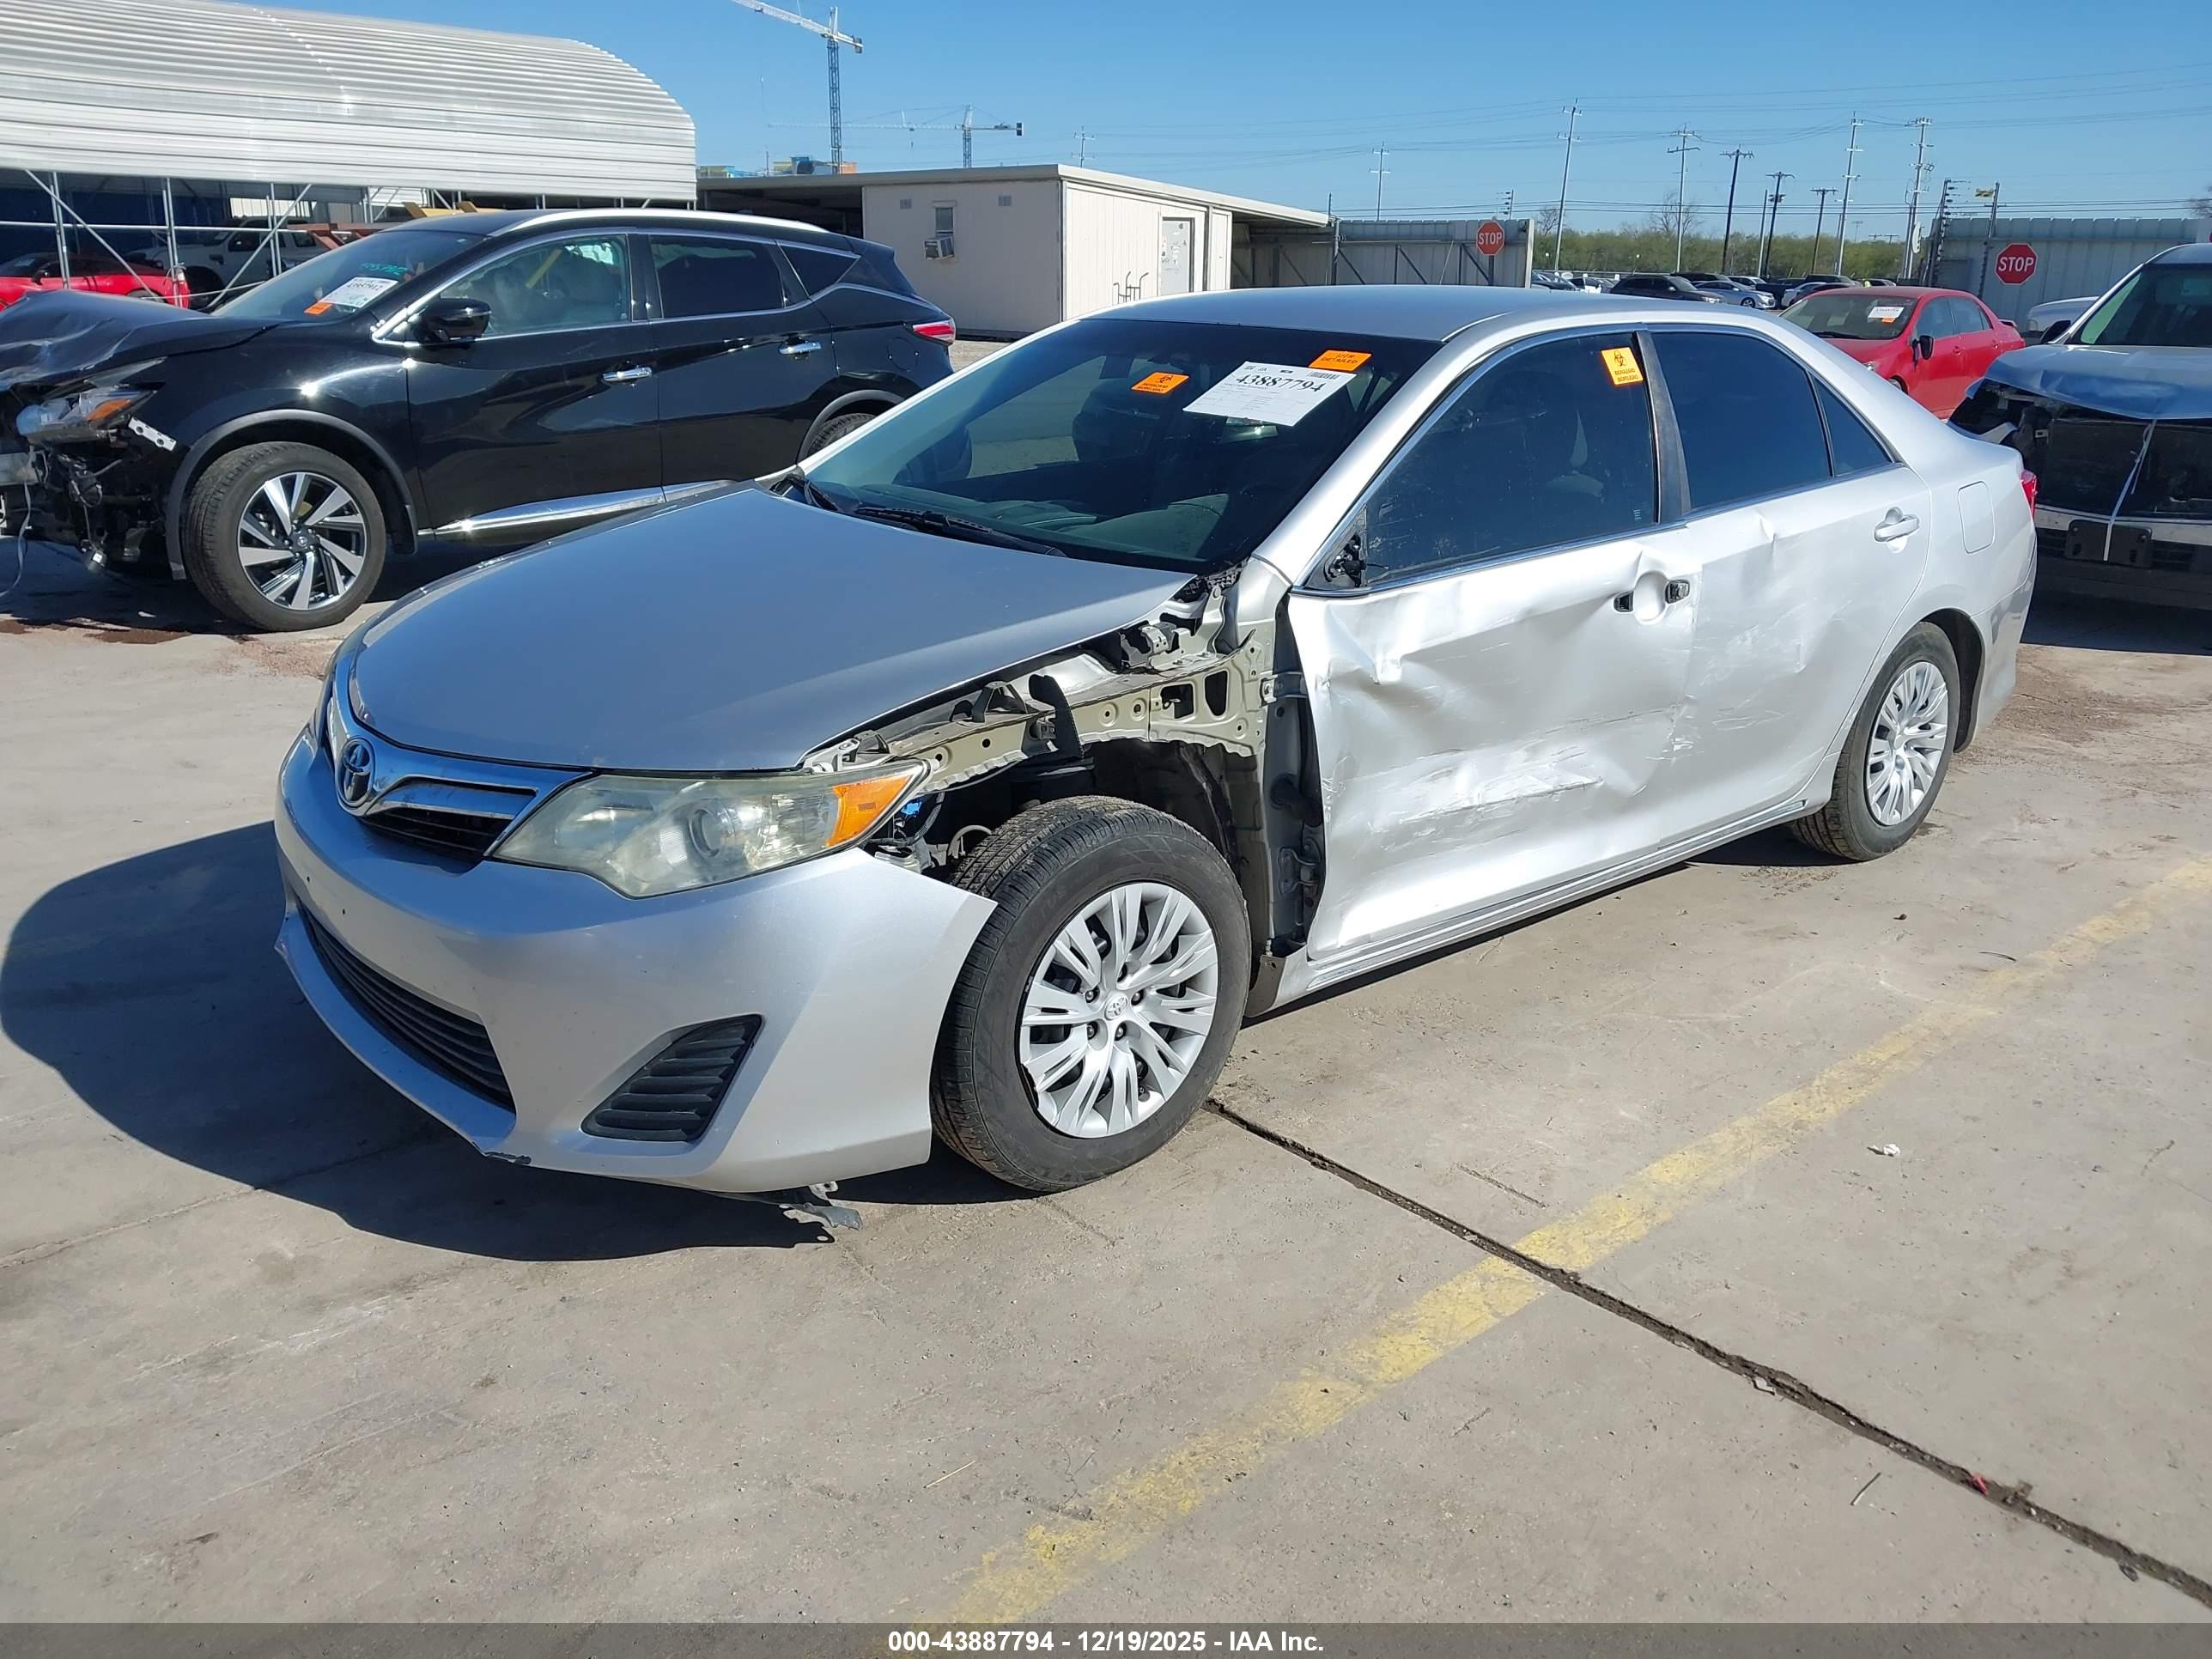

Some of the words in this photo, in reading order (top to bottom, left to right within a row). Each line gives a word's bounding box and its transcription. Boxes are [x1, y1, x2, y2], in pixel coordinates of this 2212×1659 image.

[1478, 232, 1502, 245] STOP
[1998, 256, 2034, 272] STOP
[1237, 374, 1326, 392] 43887794
